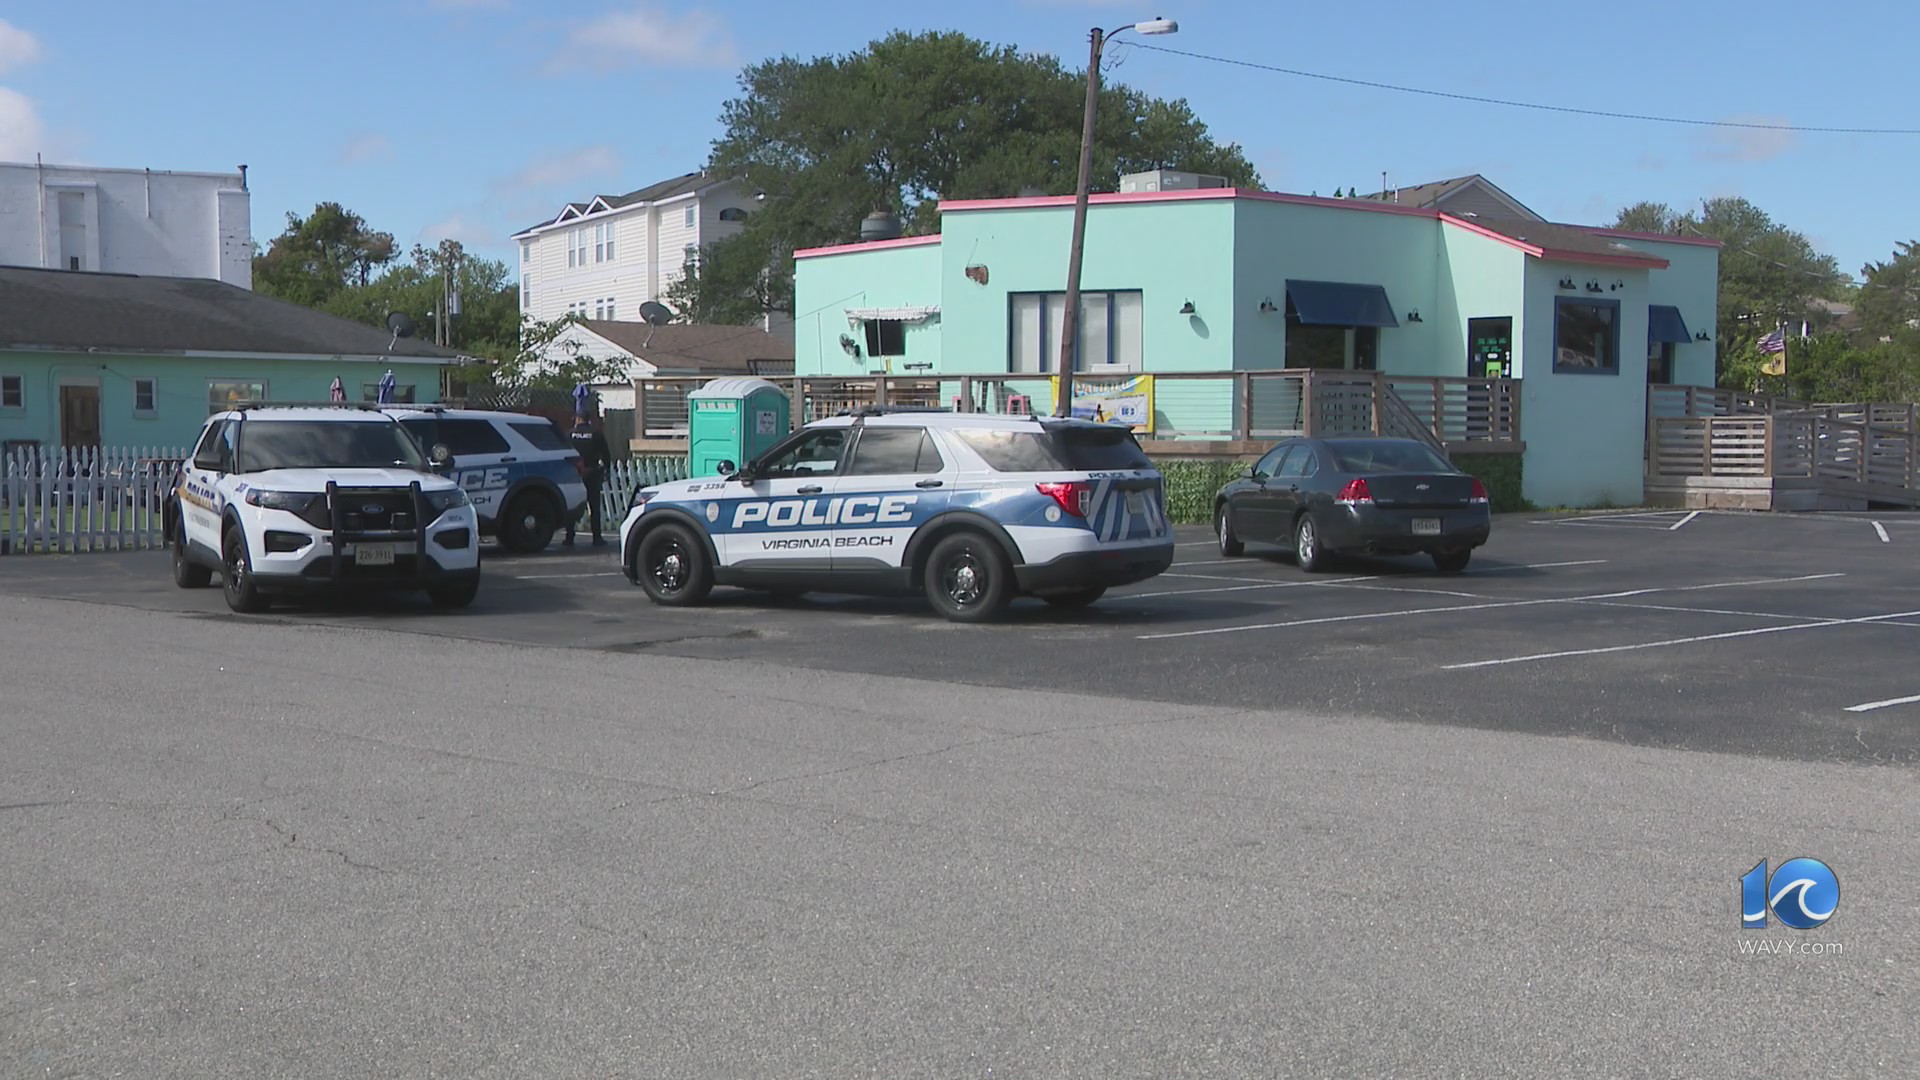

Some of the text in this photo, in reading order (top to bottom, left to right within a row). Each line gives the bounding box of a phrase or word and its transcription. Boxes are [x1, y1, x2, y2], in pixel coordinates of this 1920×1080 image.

[449, 467, 508, 488] ICE
[731, 495, 918, 529] POLICE
[761, 536, 893, 550] VIRGINIA BEACH
